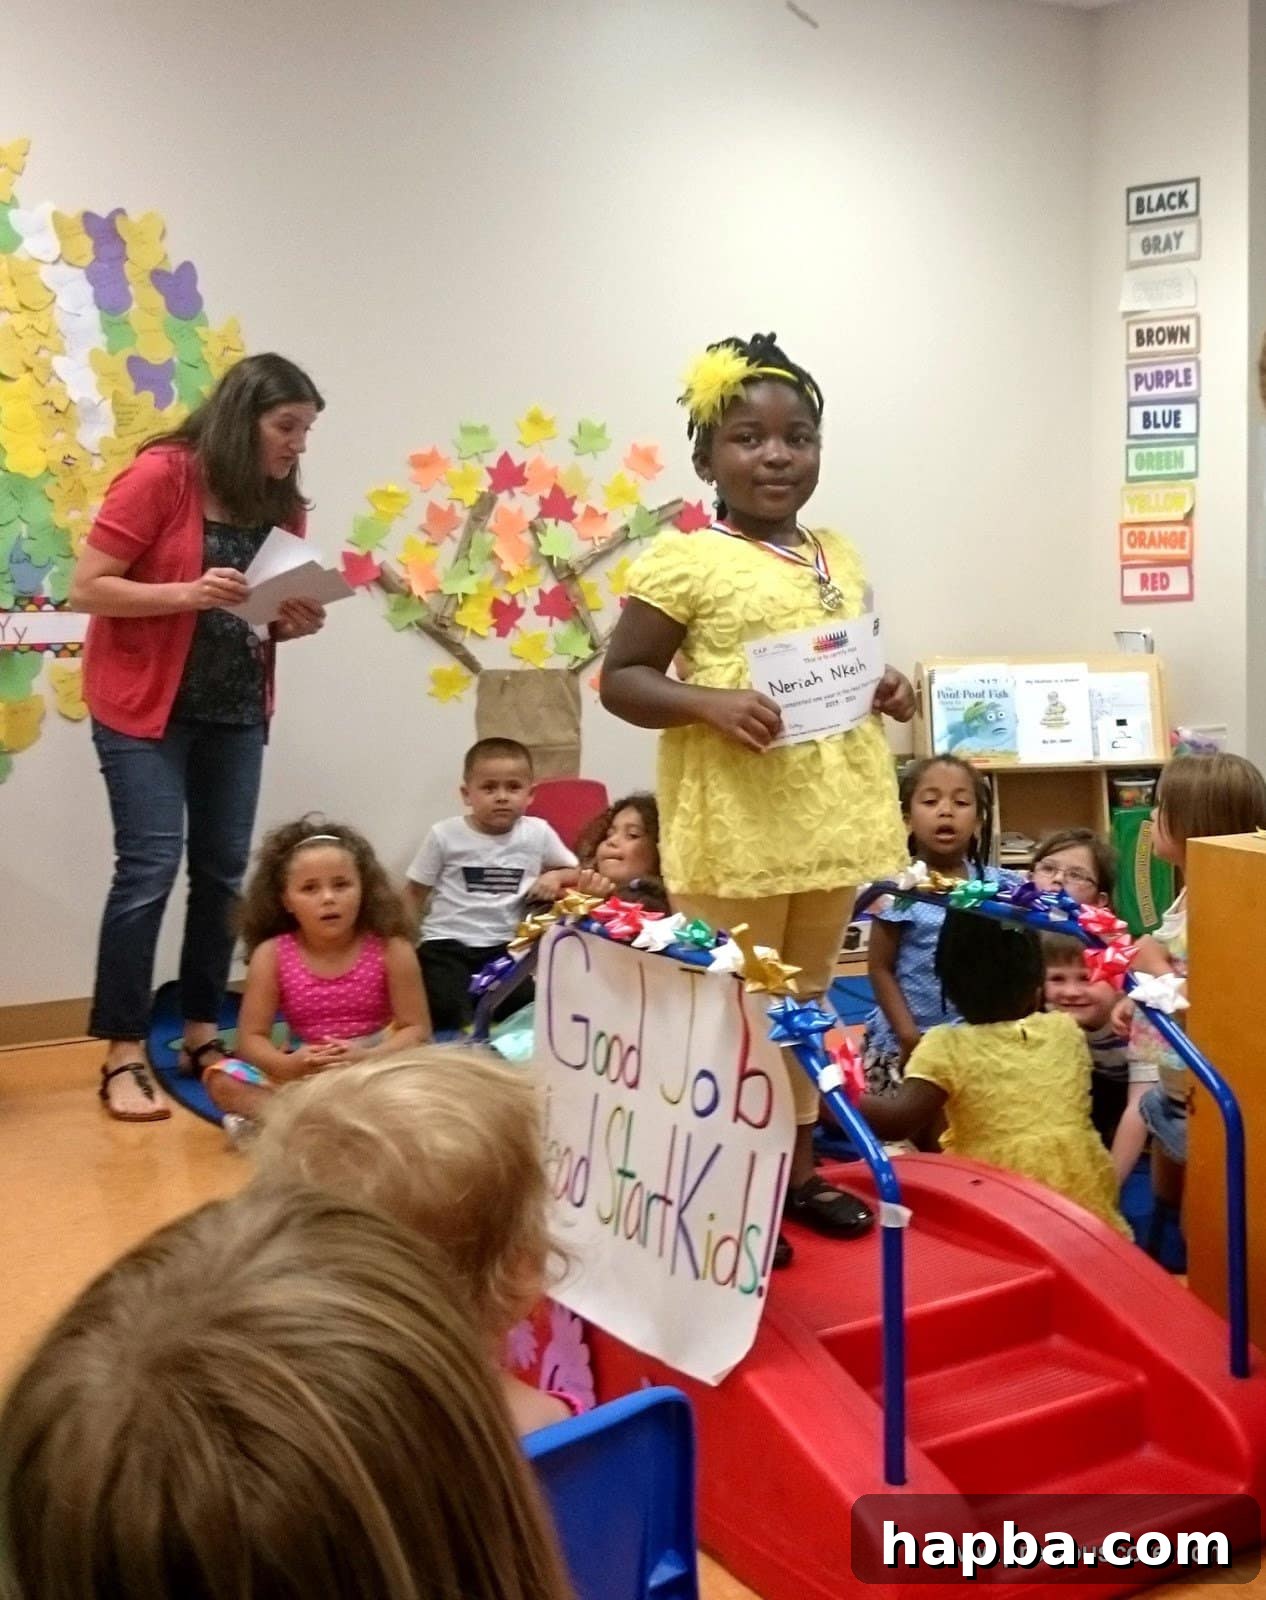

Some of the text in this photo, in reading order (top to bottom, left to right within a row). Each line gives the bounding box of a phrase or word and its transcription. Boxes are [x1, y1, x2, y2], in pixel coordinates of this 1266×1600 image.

[1135, 189, 1189, 215] BLACK
[1141, 231, 1184, 255] GRAY
[1135, 325, 1190, 347] BROWN
[1134, 367, 1192, 391] PURPLE
[1142, 409, 1181, 430] BLUE
[1135, 450, 1184, 471] GREEN
[1126, 493, 1186, 514] YELLOW
[1127, 530, 1186, 550] ORANGE
[1140, 572, 1170, 592] RED
[768, 670, 824, 697] Neriah
[830, 656, 867, 680] Nkeih
[547, 930, 773, 1130] Good Job
[597, 1105, 677, 1258] Start
[670, 1131, 788, 1299] Kids!
